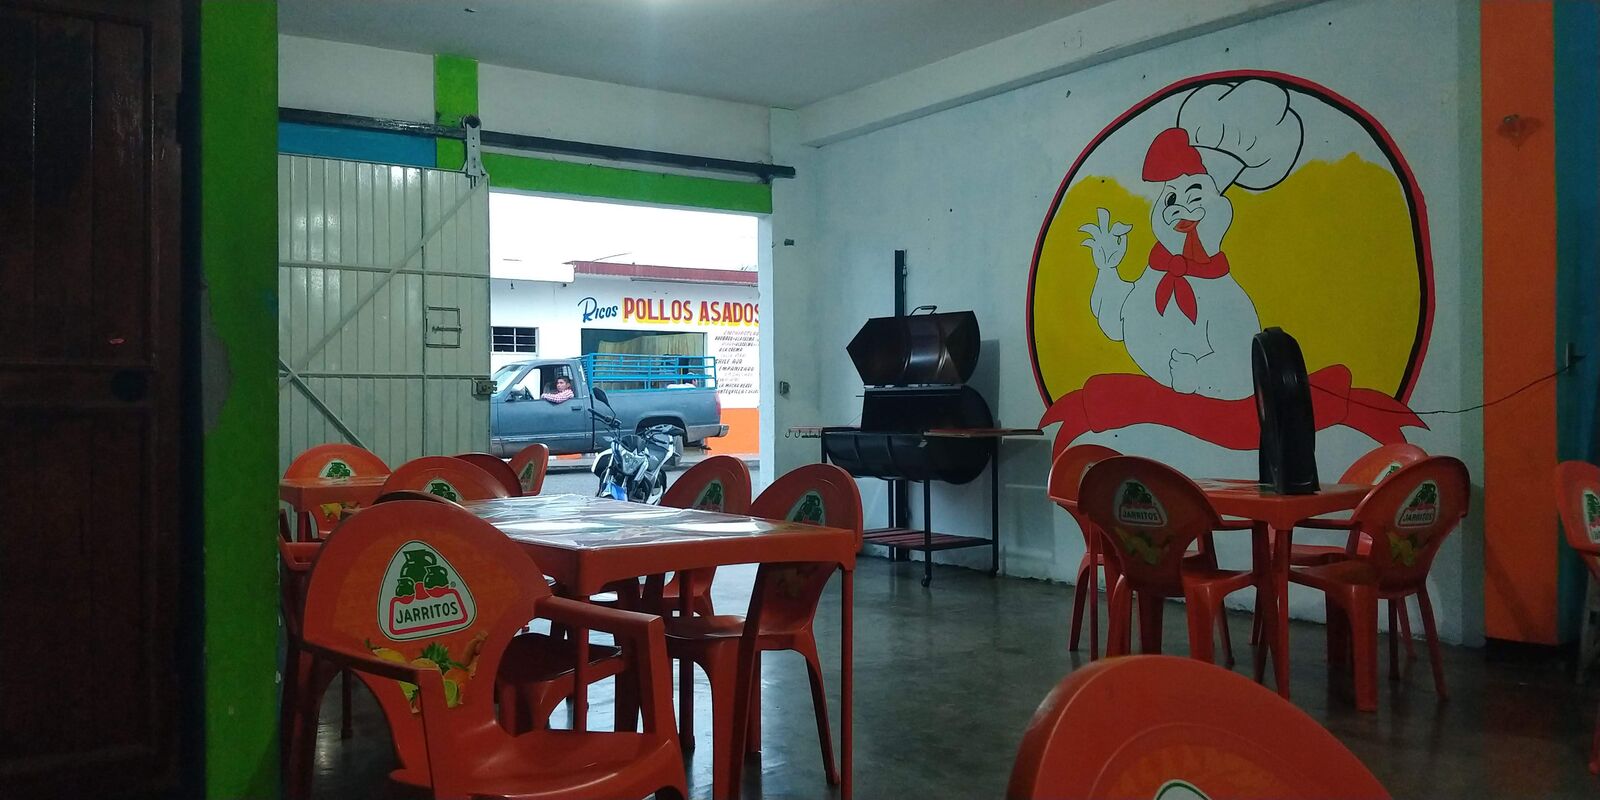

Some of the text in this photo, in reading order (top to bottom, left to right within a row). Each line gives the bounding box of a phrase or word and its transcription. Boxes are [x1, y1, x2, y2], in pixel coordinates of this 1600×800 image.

[622, 297, 693, 323] POLLOS
[1123, 511, 1158, 521] JARRITOS
[1403, 512, 1433, 522] JARRITOS
[395, 601, 459, 624] JARRITOS
